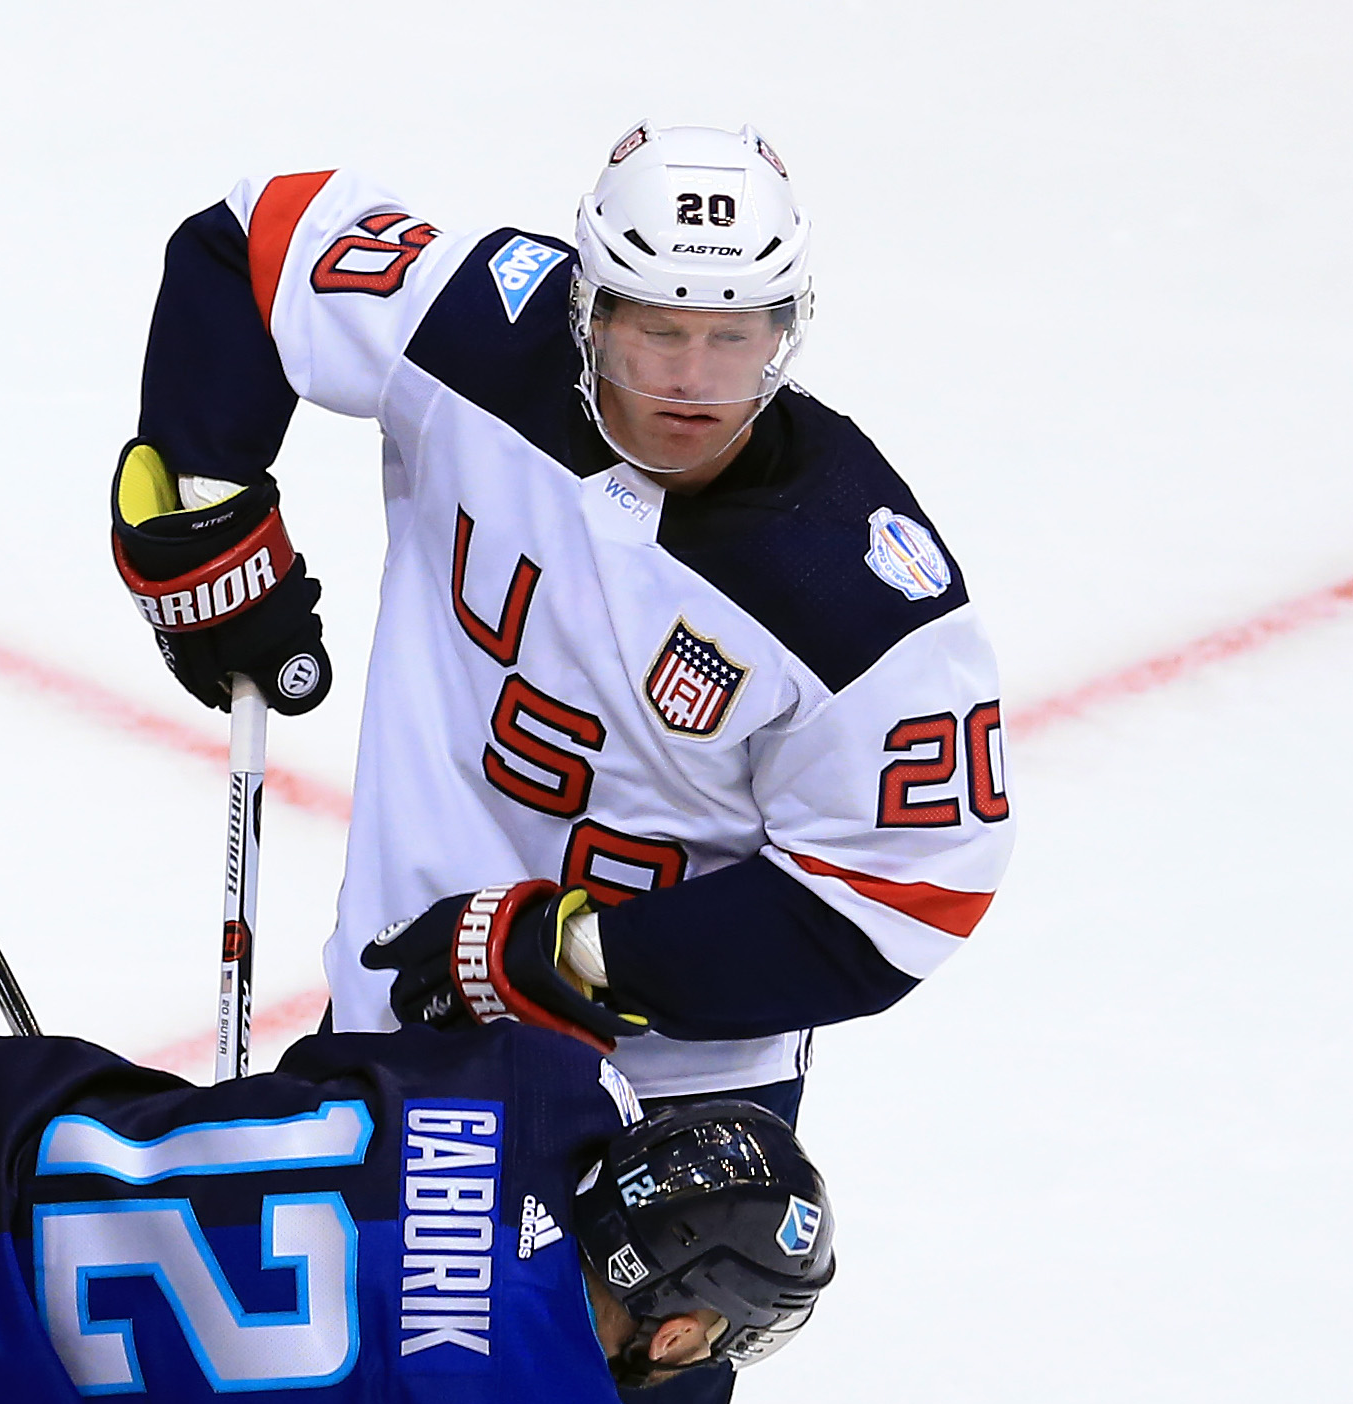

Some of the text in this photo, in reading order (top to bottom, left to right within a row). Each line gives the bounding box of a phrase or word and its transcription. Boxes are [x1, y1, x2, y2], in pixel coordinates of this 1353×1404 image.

[677, 193, 735, 227] 20
[498, 243, 552, 290] SAP
[672, 244, 743, 257] EASTON
[603, 477, 653, 524] WCH
[876, 699, 1009, 828] 20
[219, 999, 230, 1056] 20 SUTER
[617, 1164, 656, 1207] 12
[33, 1099, 374, 1396] 12
[401, 1107, 497, 1356] GABORIK
[518, 1194, 536, 1259] adidas
